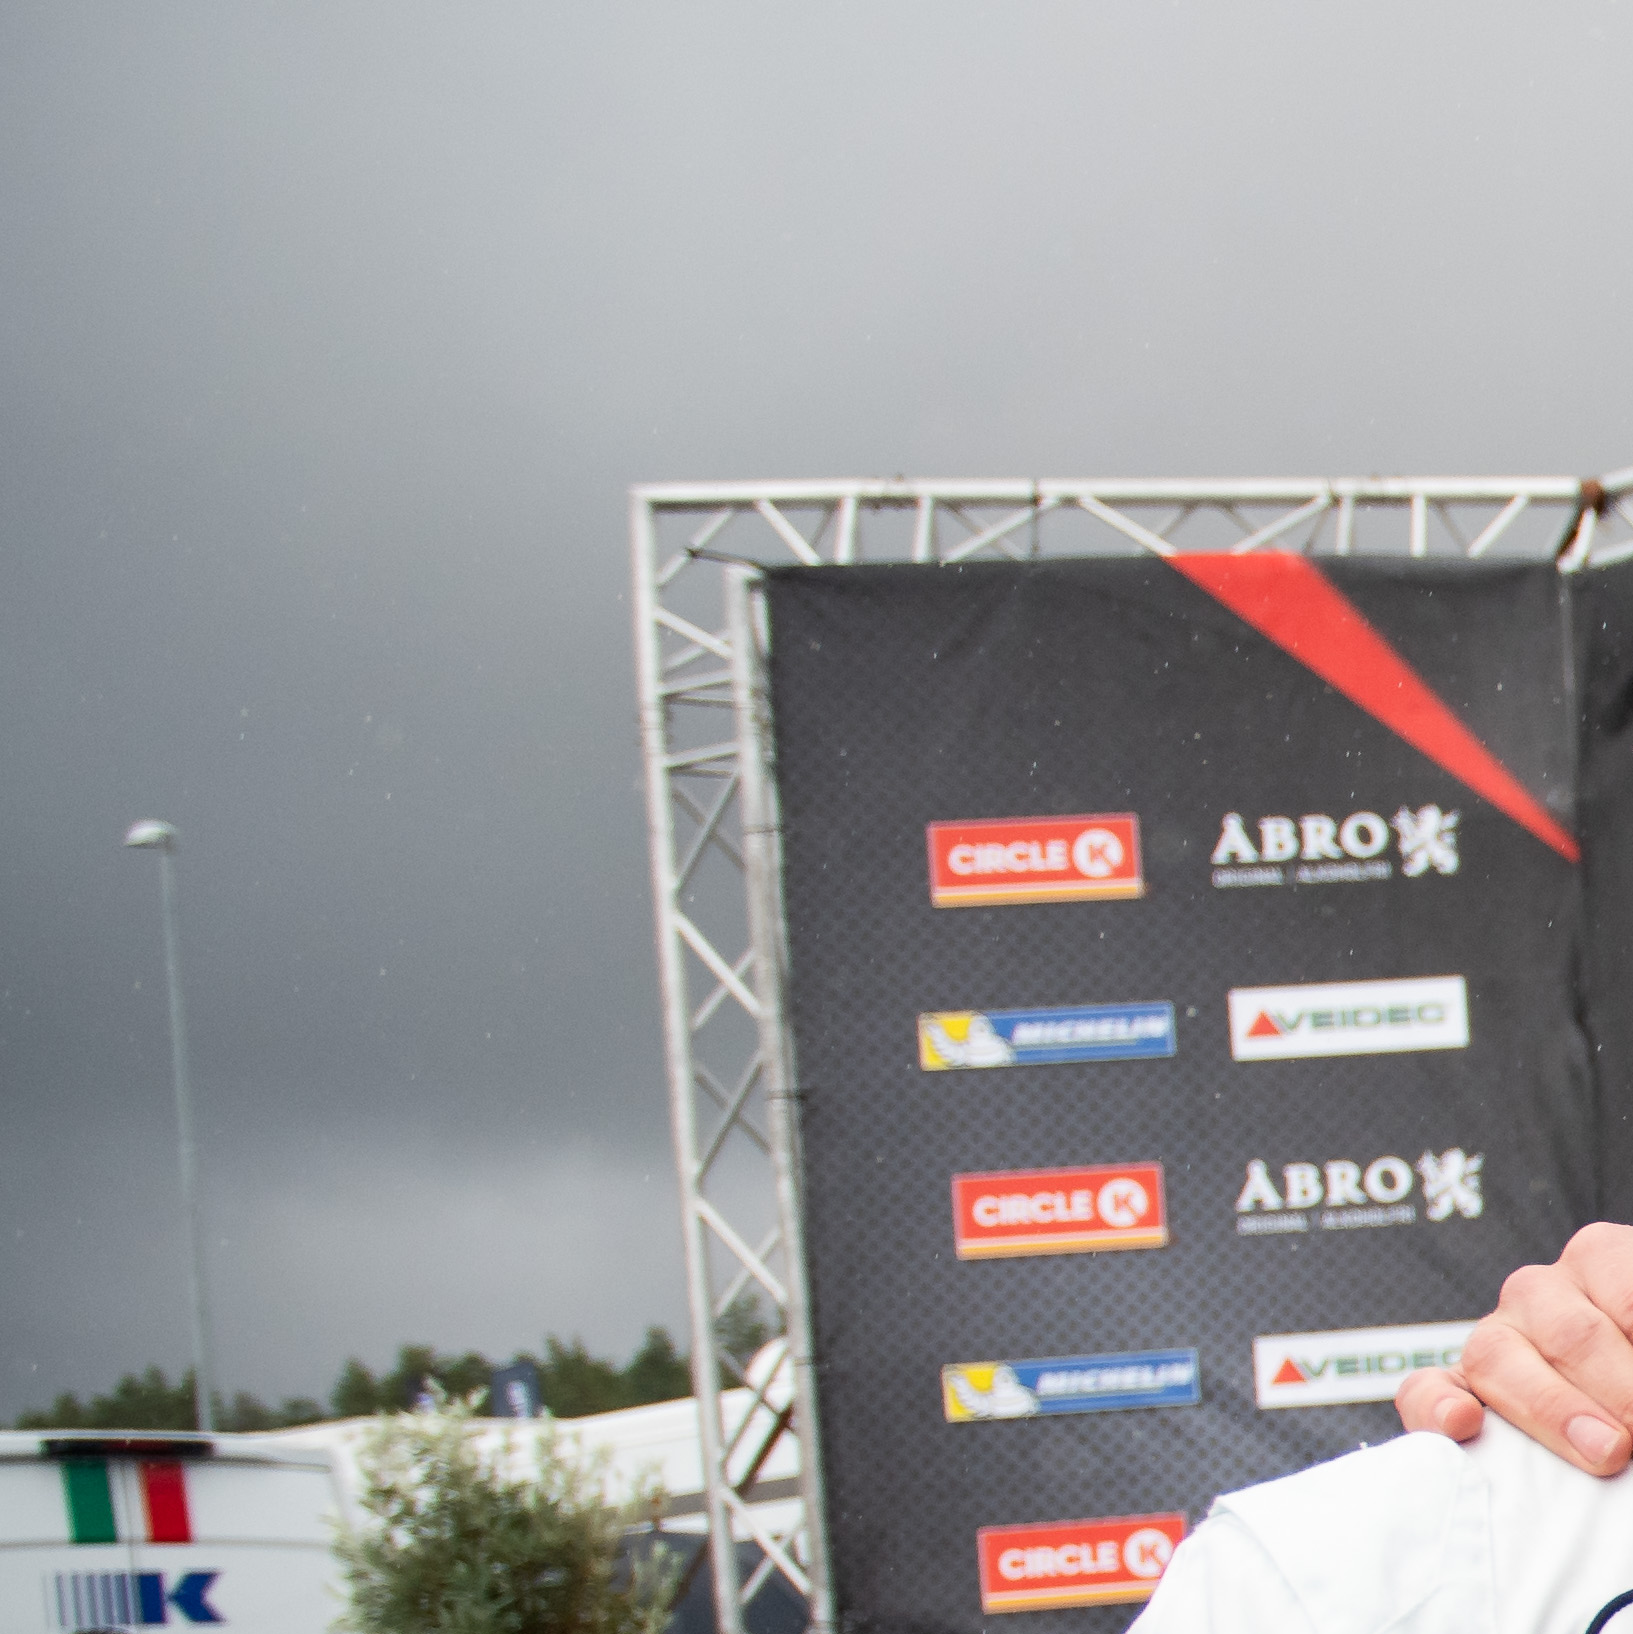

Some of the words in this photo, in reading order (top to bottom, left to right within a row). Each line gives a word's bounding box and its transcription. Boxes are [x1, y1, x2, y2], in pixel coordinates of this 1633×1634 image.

[948, 838, 1068, 877] CIRCLE
[1074, 828, 1123, 877] K
[1275, 1002, 1448, 1032] VEIDEC
[973, 1190, 1093, 1227] CIRCLE
[1098, 1178, 1148, 1227] K
[998, 1540, 1119, 1580] CIRCLE
